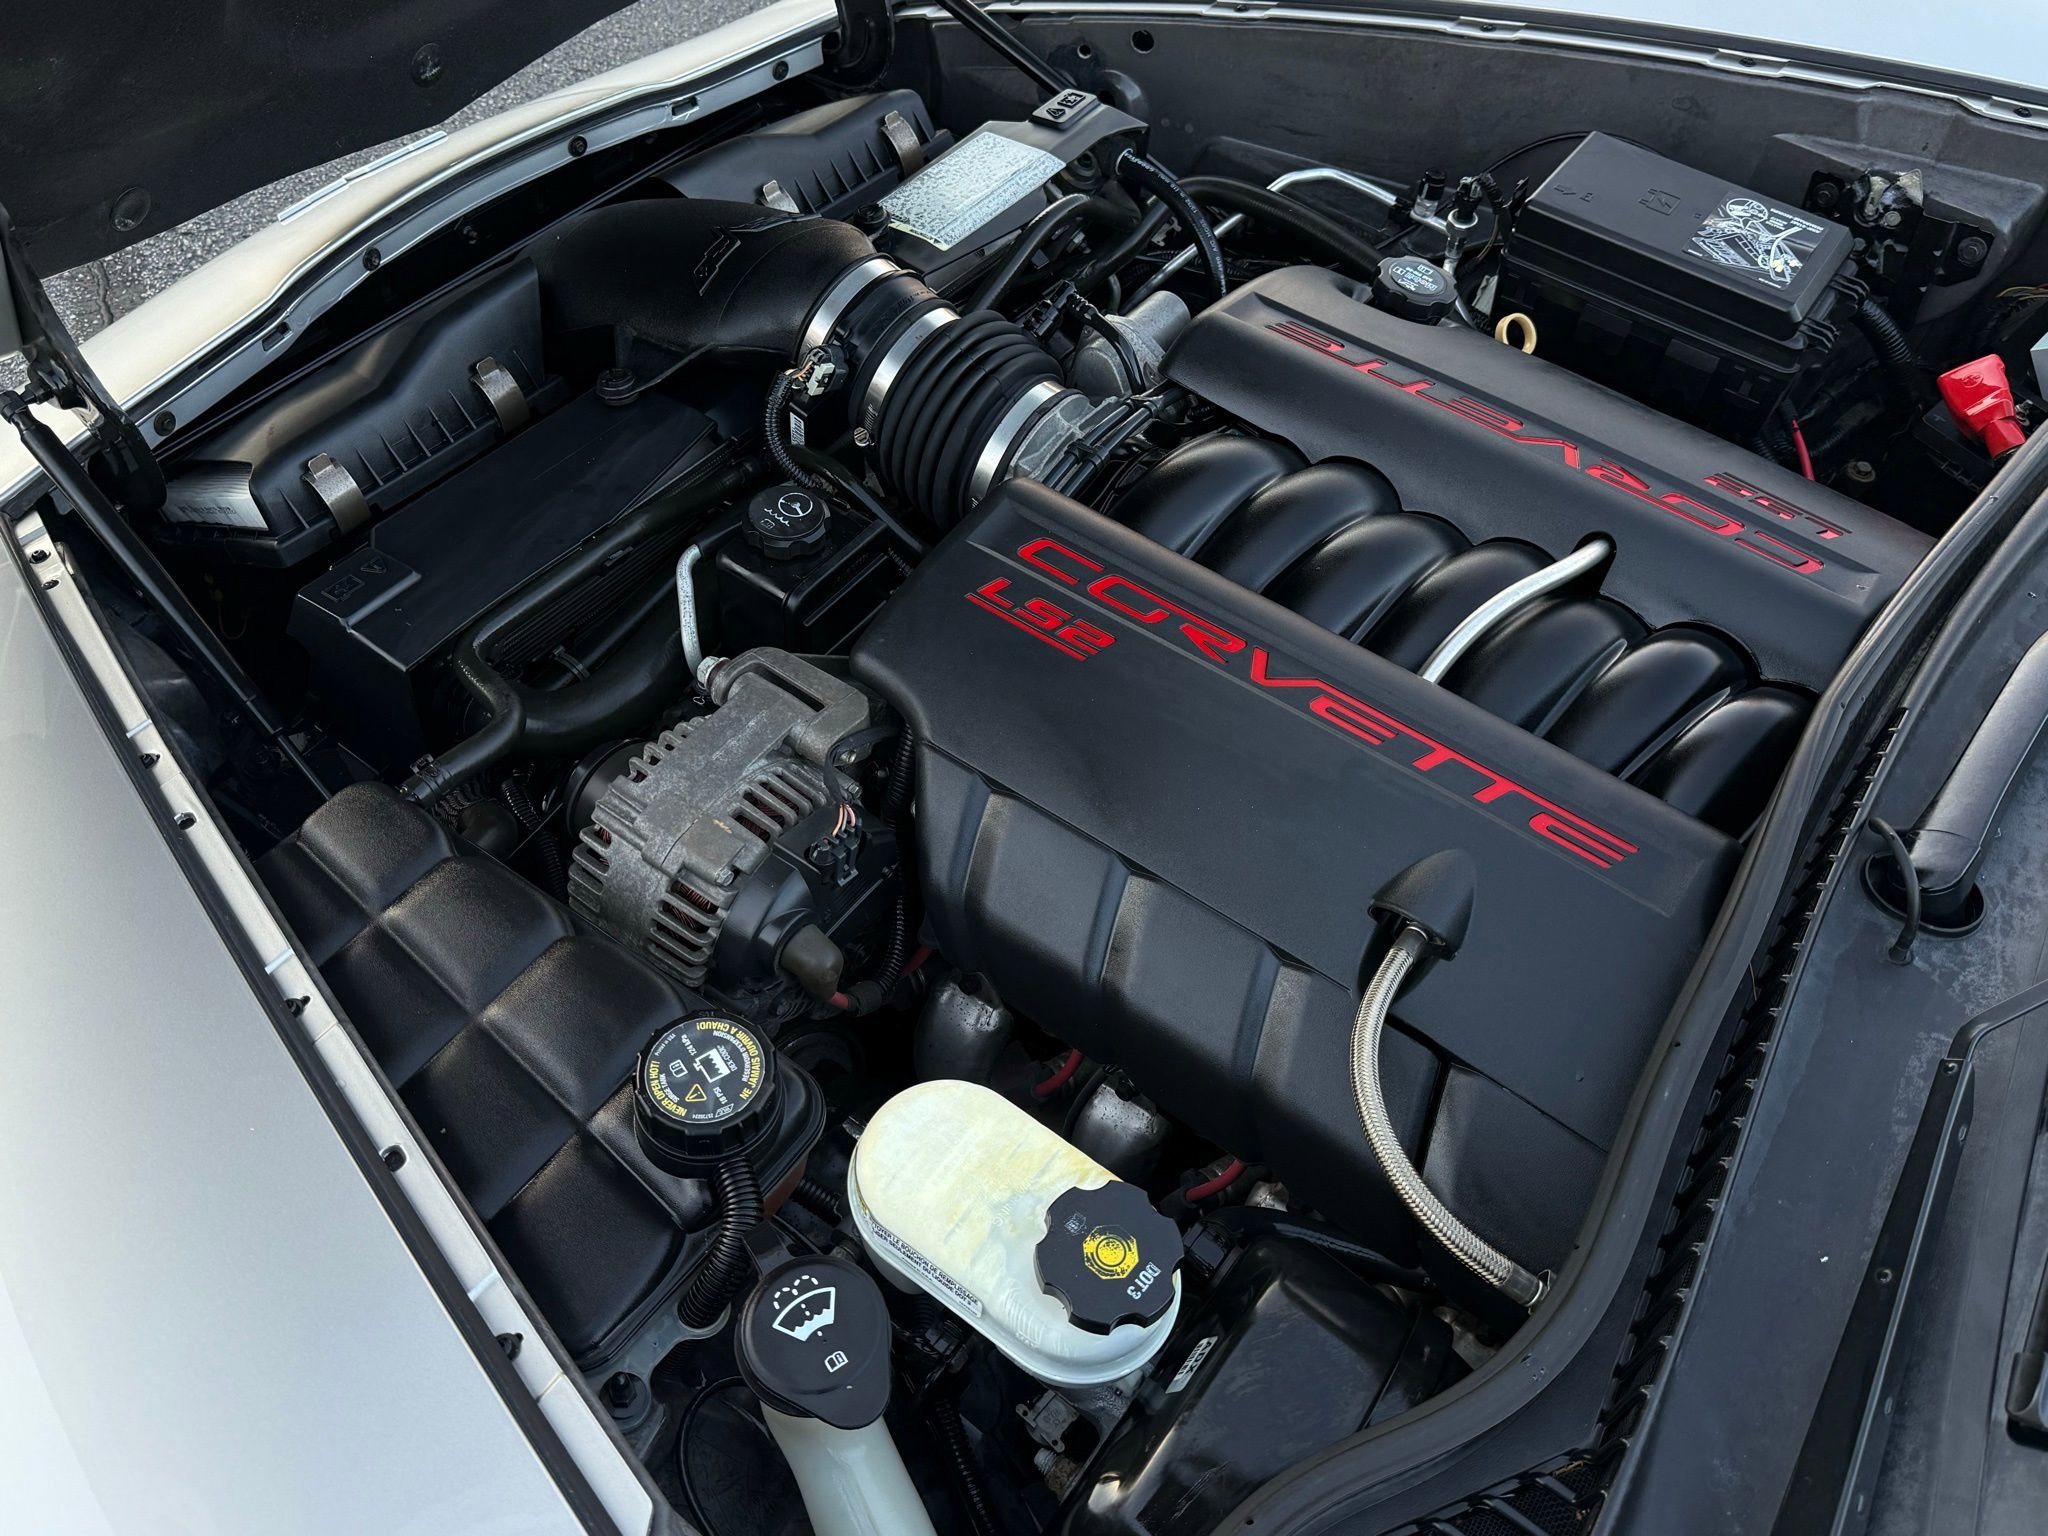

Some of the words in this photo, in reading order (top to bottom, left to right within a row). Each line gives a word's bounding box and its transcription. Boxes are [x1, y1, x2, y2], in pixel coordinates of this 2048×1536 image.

[1266, 321, 1824, 574] CORVETTE
[1703, 472, 1852, 540] LS2
[965, 577, 1116, 661] LS2
[1016, 536, 1640, 869] CORVETTE
[696, 1021, 730, 1031] CHAUD!
[730, 1026, 736, 1034] A
[688, 1045, 698, 1056] 124
[736, 1031, 758, 1056] OUVRIR
[649, 1061, 660, 1079] HOT!
[750, 1057, 761, 1088] JAMAIS
[651, 1079, 664, 1099] OPEN
[659, 1073, 669, 1088] TANK
[739, 1088, 752, 1100] NE
[661, 1098, 688, 1117] NEVER
[1134, 1261, 1162, 1293] DOT
[1126, 1285, 1142, 1300] 3
